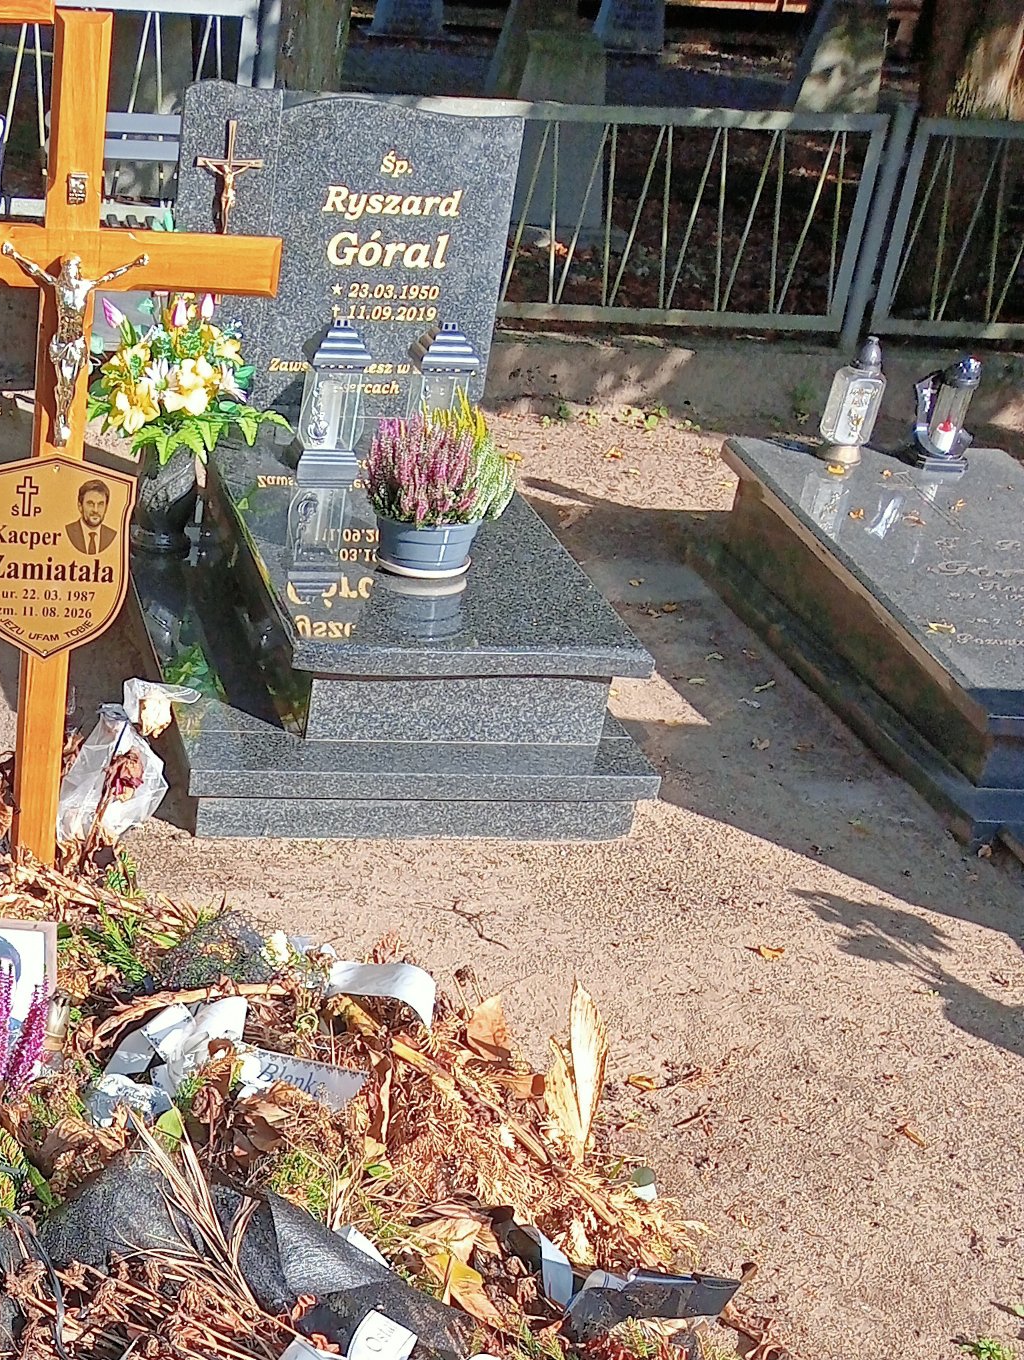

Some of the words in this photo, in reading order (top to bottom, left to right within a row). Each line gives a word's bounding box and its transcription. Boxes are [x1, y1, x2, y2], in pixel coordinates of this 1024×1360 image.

[380, 150, 413, 178] Śp.
[322, 185, 463, 220] Ryszard
[327, 230, 450, 270] Góral
[347, 283, 440, 300] 23.03.1950
[347, 306, 437, 323] 11.09.2019
[1, 590, 18, 600] ur.
[22, 588, 40, 600] 22.
[44, 589, 62, 601] 03.
[67, 590, 96, 602] 1987
[22, 606, 38, 617] 11.
[42, 606, 60, 617] 08.
[64, 607, 92, 619] 2026
[0, 617, 25, 636] JEZU
[28, 632, 60, 642] UFAM
[64, 620, 94, 640] TOBIE
